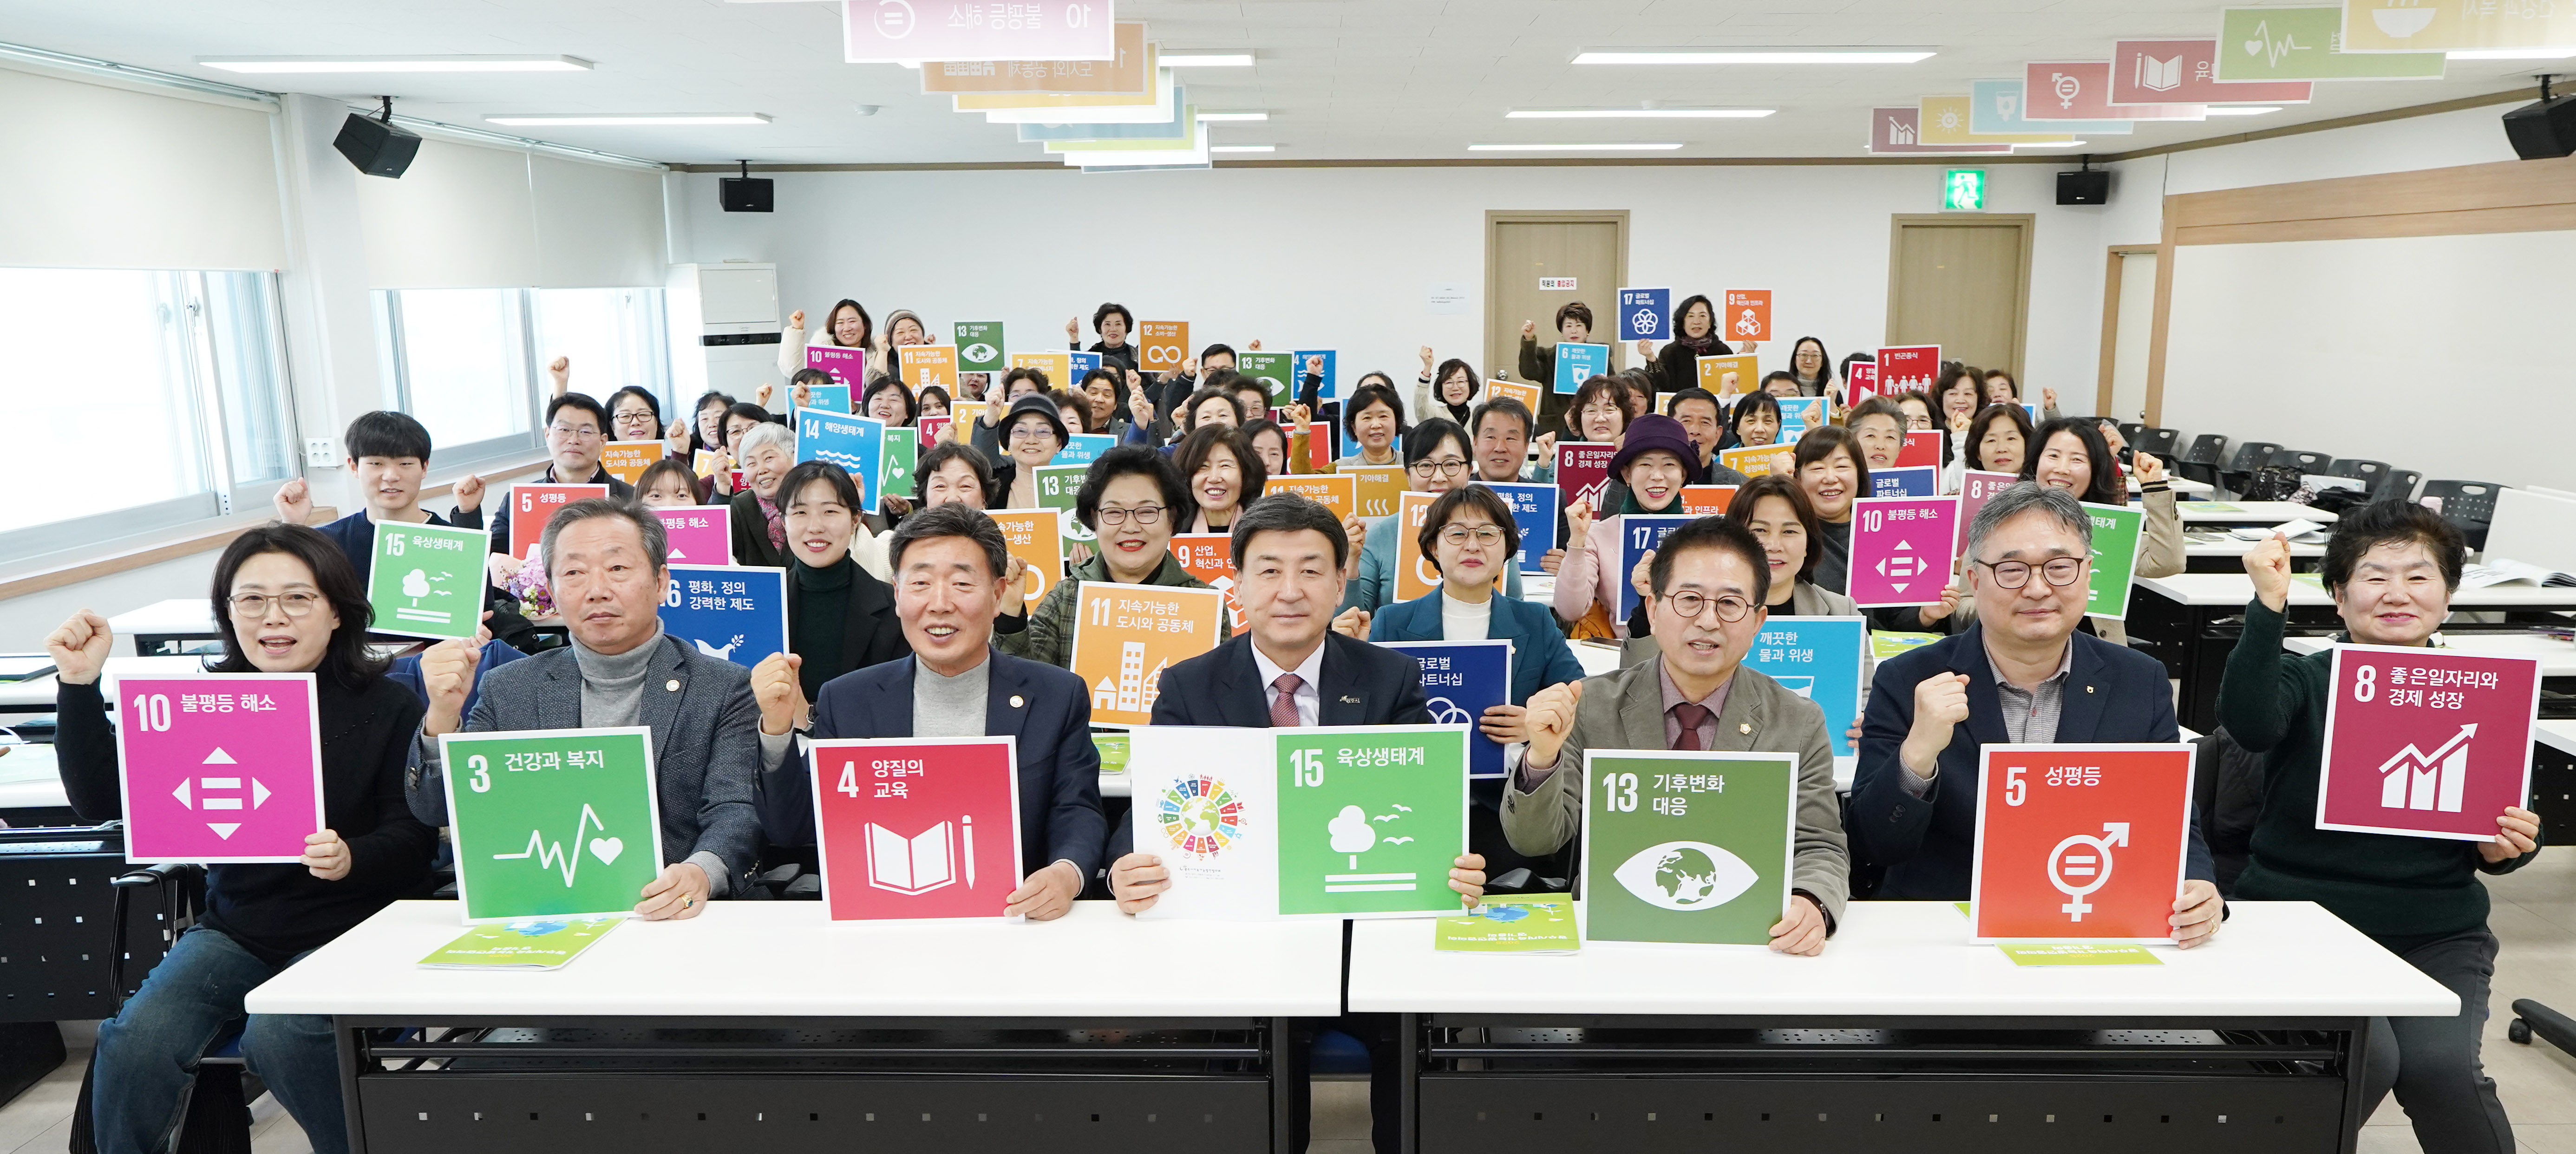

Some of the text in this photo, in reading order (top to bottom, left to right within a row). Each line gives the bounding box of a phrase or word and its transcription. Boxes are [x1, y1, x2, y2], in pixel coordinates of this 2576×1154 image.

[1624, 293, 1633, 305] 17
[1729, 293, 1735, 305] 9
[957, 326, 967, 337] 13
[1143, 325, 1152, 335] 12
[811, 350, 822, 363] 10
[904, 352, 913, 364] 11
[1562, 347, 1569, 359] 6
[1884, 353, 1890, 366] 1
[1017, 359, 1023, 368] 7
[1242, 357, 1252, 369] 13
[1704, 363, 1711, 376] 2
[1855, 368, 1862, 379] 4
[1491, 385, 1501, 397] 12
[1504, 387, 1527, 396] 지속가능한
[960, 409, 967, 423] 2
[804, 418, 864, 439] 14 해양생태계
[926, 423, 933, 436] 4
[605, 450, 641, 458] 지속가능한
[1564, 450, 1574, 467] 8
[605, 458, 650, 468] 도시와 공동체
[703, 459, 710, 472] 7
[1730, 458, 1738, 470] 7
[1360, 474, 1390, 483] 기아해결
[1876, 478, 1899, 489] 글로벌
[1042, 476, 1059, 496] 13
[1288, 484, 1329, 494] 지속가능한
[1971, 480, 1982, 498] 8
[1517, 493, 1533, 502] 정의
[1876, 489, 1908, 497] 파트너십
[522, 493, 566, 512] 5 성평등
[1521, 503, 1538, 513] 제도
[1411, 504, 1427, 527] 12
[1695, 506, 1719, 514] 인프라
[688, 517, 709, 528] 해소
[998, 520, 1034, 532] 속가능한
[1863, 508, 1938, 532] 10 불평등 해소
[385, 533, 464, 556] 15 육상생태계
[1633, 527, 1651, 549] 17
[1178, 545, 1190, 568] 9
[1194, 545, 1217, 557] 산업,
[1195, 558, 1224, 569] 혁신과
[688, 580, 745, 595] 평화, 정의
[689, 597, 755, 611] 강력한 제도
[1118, 599, 1179, 615] 지속가능한
[1091, 597, 1111, 626] 11
[1116, 616, 1194, 634] 도시와 공동체
[1759, 632, 1798, 645] 깨끗한
[1759, 648, 1813, 663] 물과 위생
[2354, 665, 2377, 702] 8
[2389, 666, 2498, 690] 좋은일자리와
[2388, 688, 2465, 710] 경제 성장
[133, 694, 277, 732] 10 불평등 해소
[468, 750, 604, 793] 3 건강과 복지
[871, 759, 924, 778] 양질의
[1290, 747, 1424, 787] 15 육상생태계
[837, 761, 859, 798] 4
[1653, 773, 1725, 793] 기후변화
[874, 782, 909, 799] 교육
[1602, 772, 1639, 812] 13
[2005, 766, 2102, 807] 5 성평등
[1653, 796, 1688, 816] 대응
